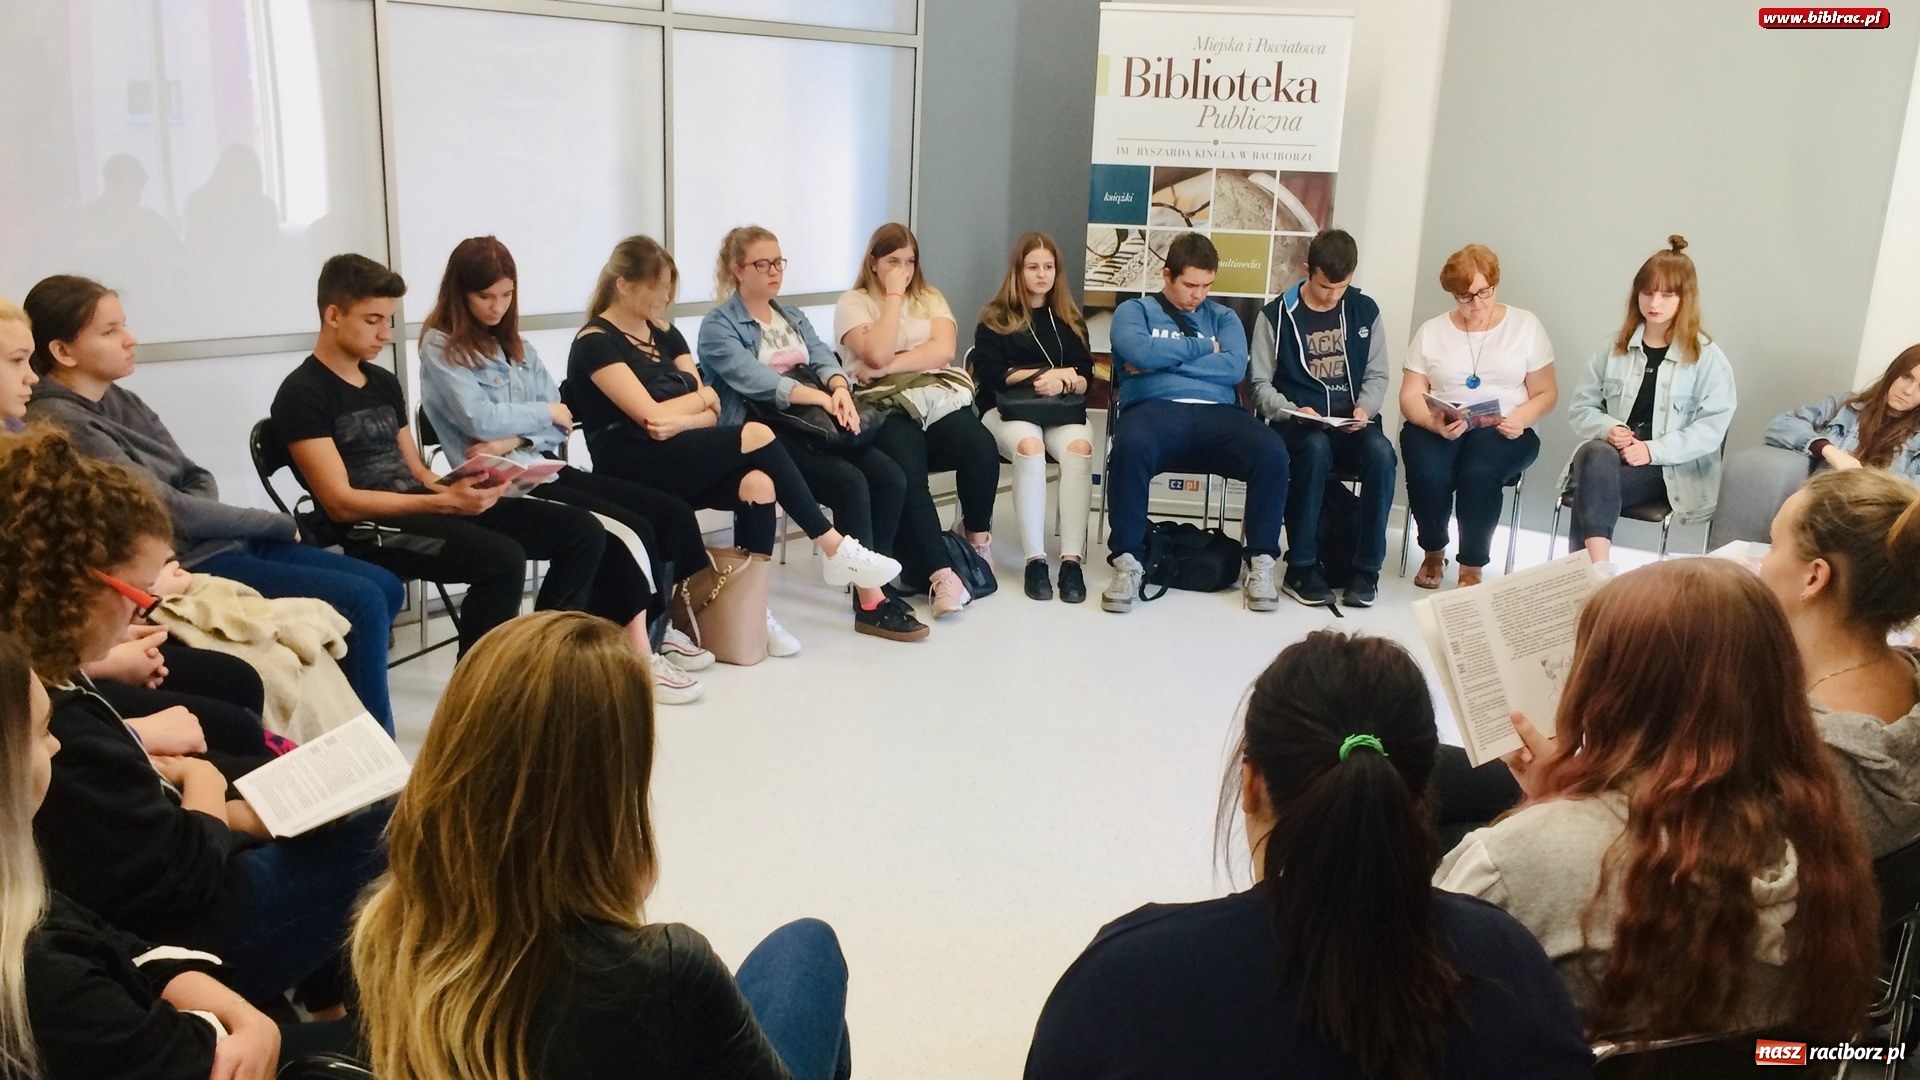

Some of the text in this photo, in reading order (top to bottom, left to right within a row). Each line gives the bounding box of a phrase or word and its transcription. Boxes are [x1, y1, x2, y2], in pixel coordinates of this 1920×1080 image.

[1193, 36, 1327, 56] Miejska i Powiatowa
[1120, 55, 1321, 104] Biblioteka
[1196, 105, 1303, 134] Publiczna
[1137, 147, 1191, 157] RYSZARDA
[1239, 150, 1247, 159] W
[1252, 151, 1313, 162] RACIBORZU
